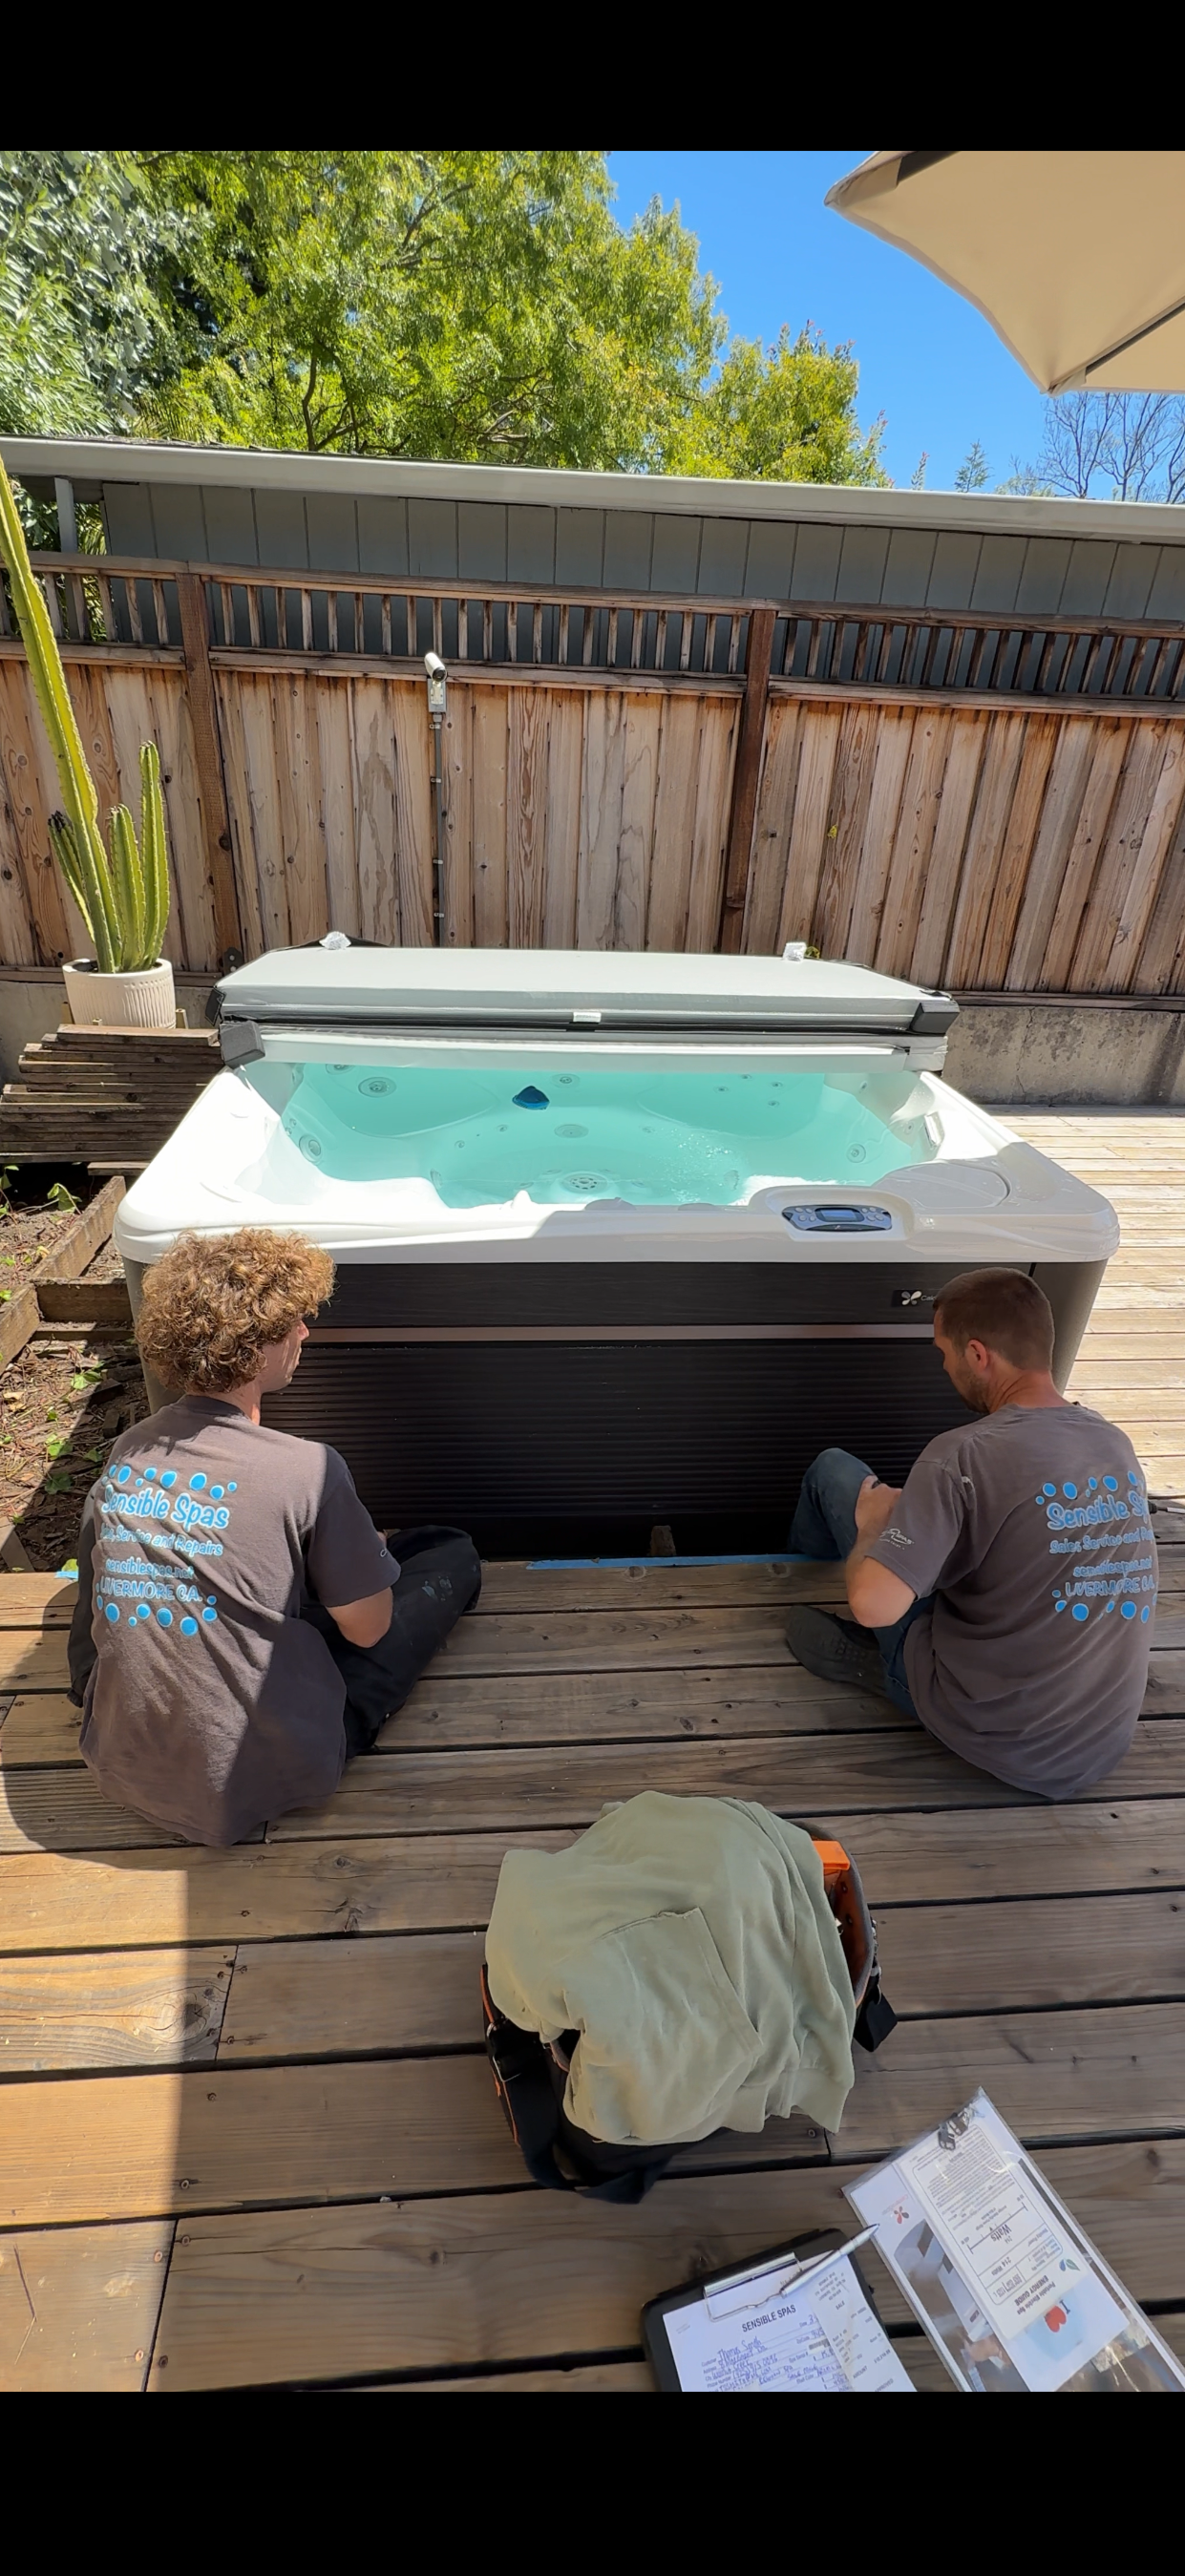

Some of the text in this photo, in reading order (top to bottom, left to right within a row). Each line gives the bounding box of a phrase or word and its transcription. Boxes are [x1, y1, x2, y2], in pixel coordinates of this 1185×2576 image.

[171, 1493, 230, 1532] Spas
[1047, 1490, 1150, 1530] Sensible Sp
[150, 1531, 175, 1548] and
[176, 1533, 223, 1556] Repairs
[1082, 1534, 1122, 1551] Service
[1123, 1528, 1140, 1544] and
[100, 1576, 175, 1601] LIVERMORE
[1066, 1576, 1140, 1596] LIVERMORE
[989, 2223, 1011, 2243] Watts
[1004, 2235, 1012, 2244] 214
[1000, 2255, 1011, 2267] 214
[1027, 2274, 1048, 2293] ENERGY
[1013, 2290, 1030, 2306] GUIDE
[741, 2304, 795, 2332] SENSIBLE SPAS
